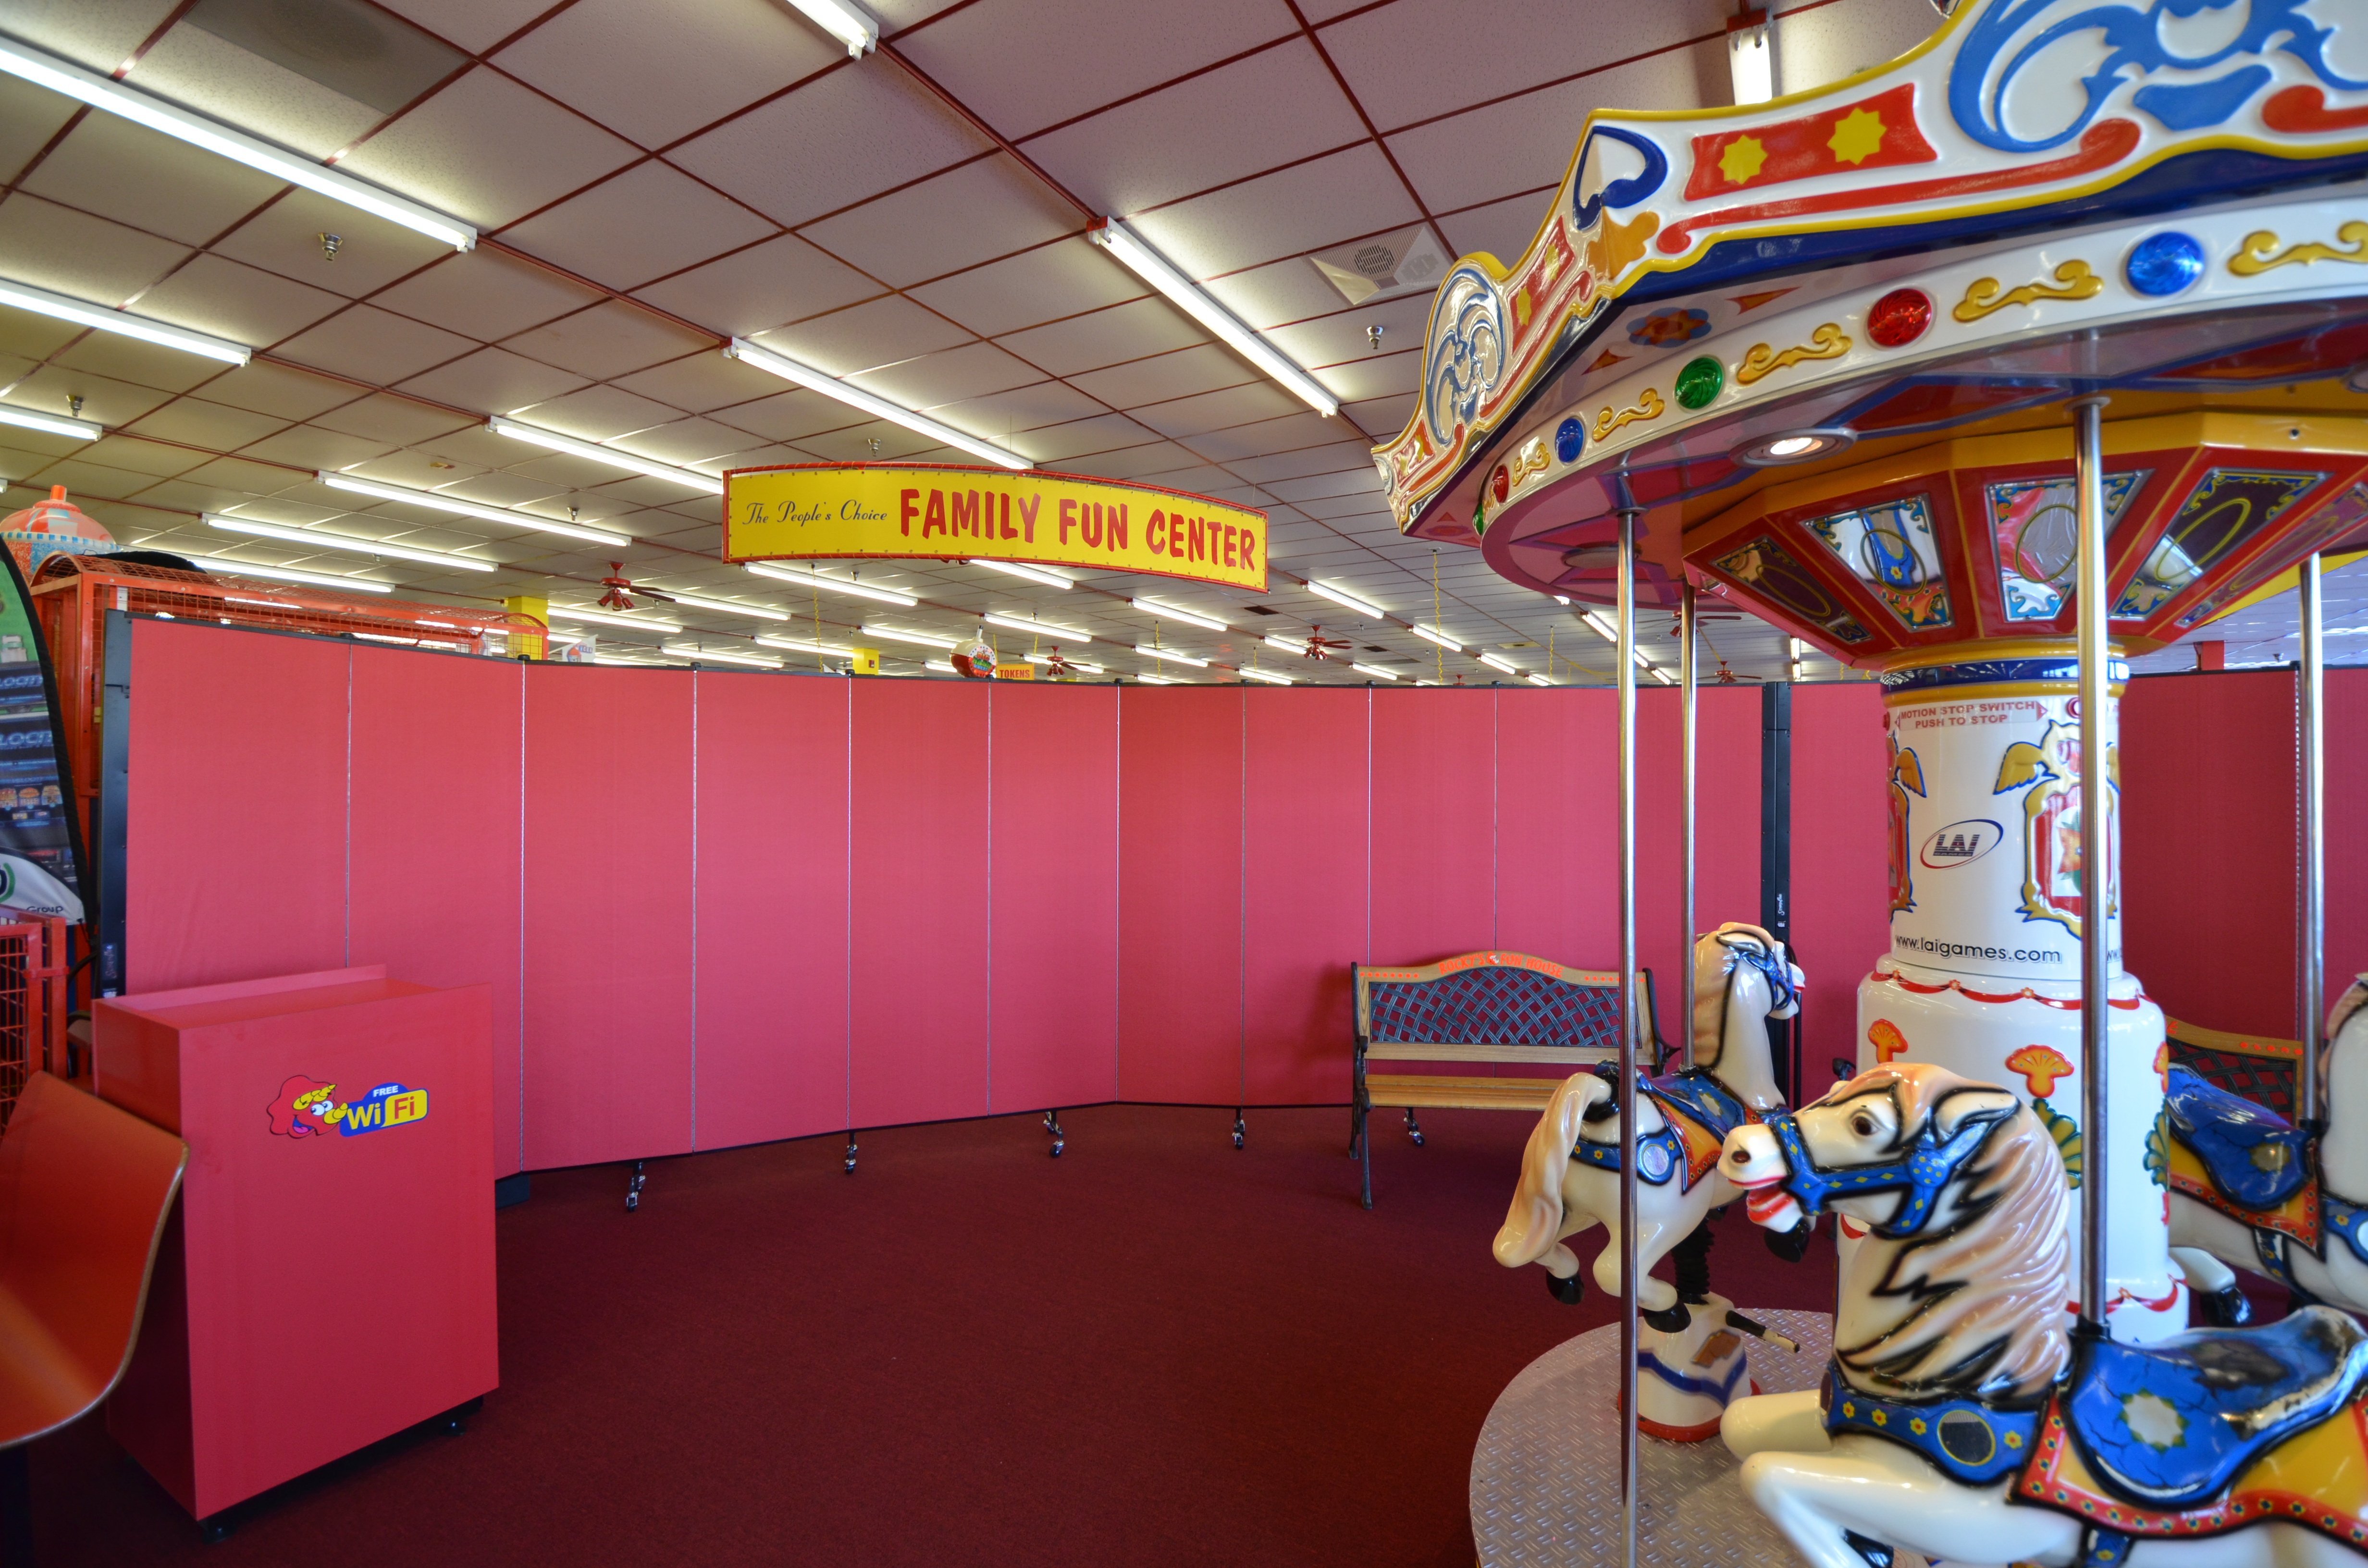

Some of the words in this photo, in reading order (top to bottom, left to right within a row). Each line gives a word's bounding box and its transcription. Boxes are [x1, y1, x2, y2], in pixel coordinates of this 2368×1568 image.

[742, 502, 769, 525] The
[777, 500, 832, 527] People's
[840, 499, 888, 521] Choice
[900, 488, 1041, 544] FAMILY
[1059, 498, 1128, 552] FUN
[1146, 508, 1256, 572] CENTER
[999, 669, 1030, 678] TOKENS
[1901, 707, 1936, 719] MOTION
[1940, 704, 1974, 715] STOP
[1979, 701, 2035, 712] SWITCH
[1915, 718, 1944, 729] PUSH
[1948, 716, 1966, 725] TO
[1970, 714, 2008, 724] STOP
[1933, 834, 1980, 852] LAI
[1895, 935, 2060, 962] www.laigames.com
[1438, 953, 1485, 975] ROCKY'S
[1500, 953, 1523, 967] FUN
[1525, 957, 1565, 978] HOUSE
[373, 1085, 398, 1097] FREE
